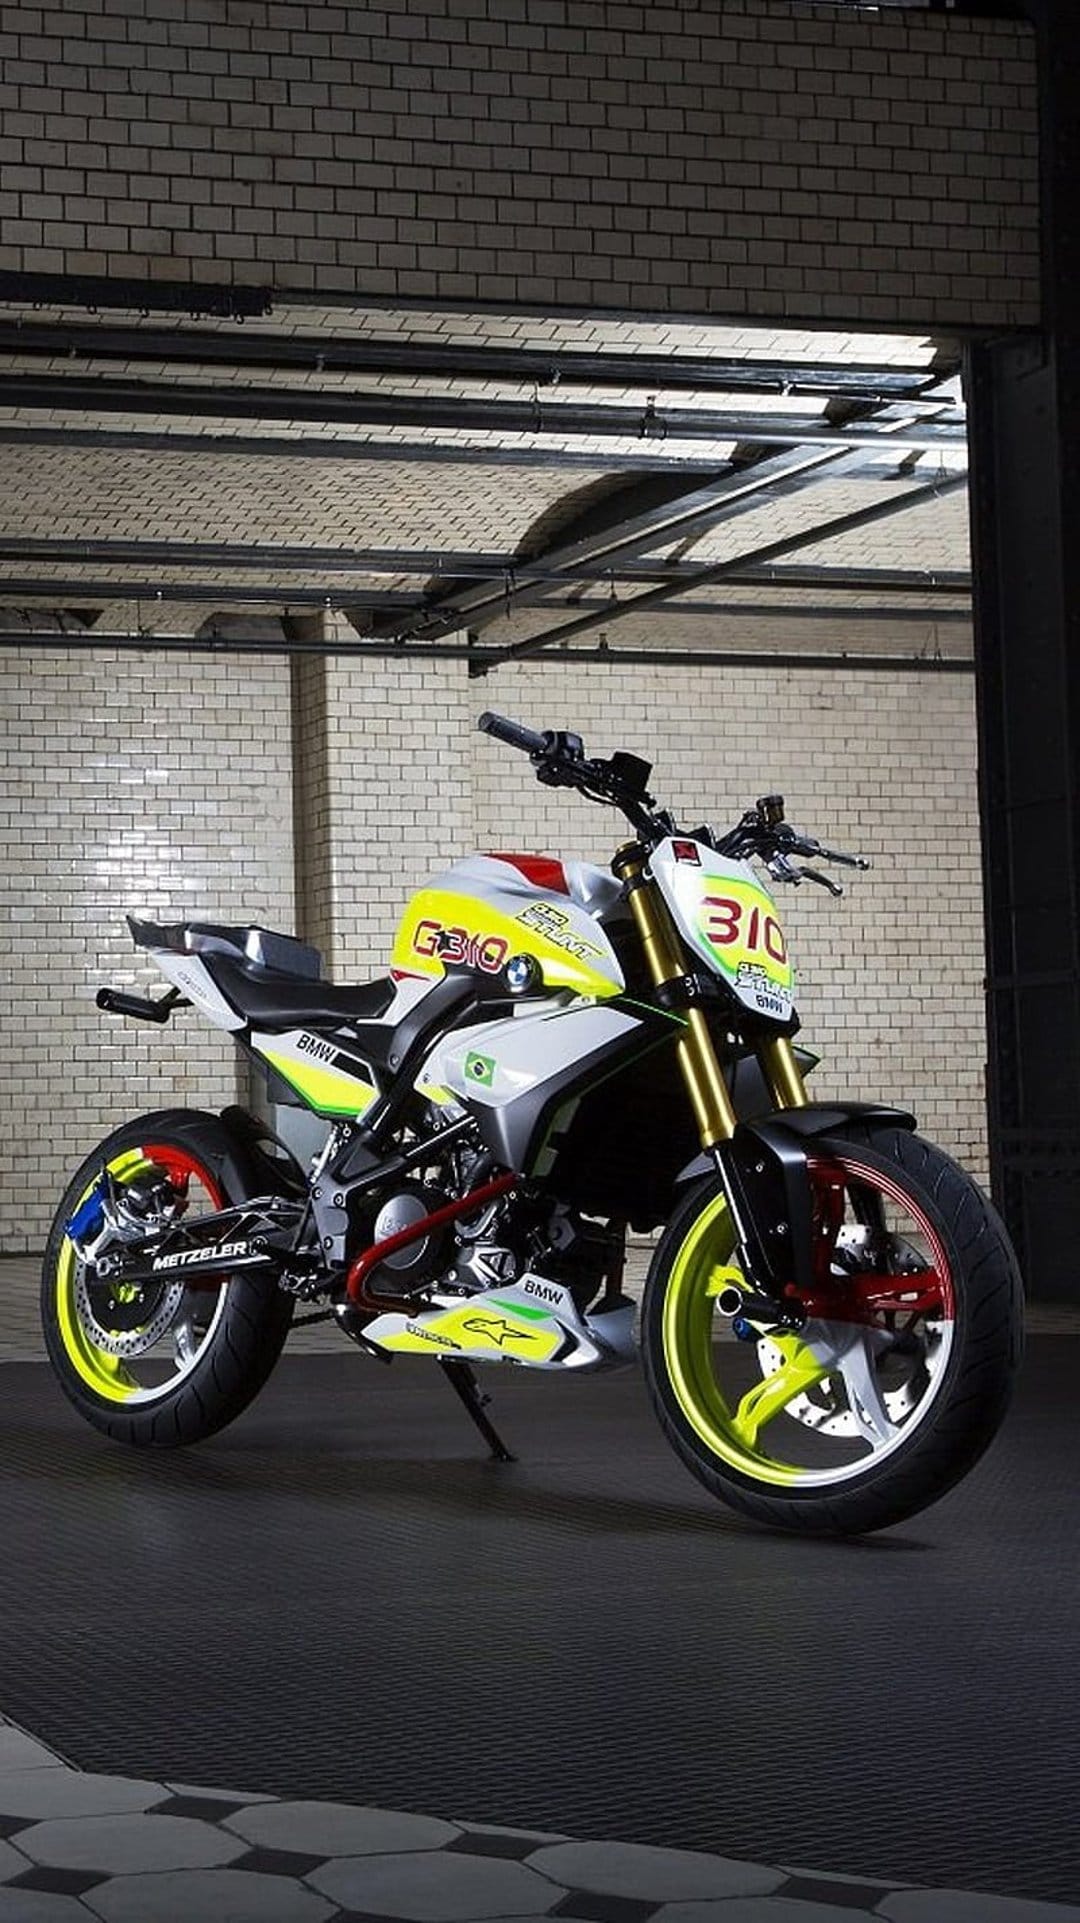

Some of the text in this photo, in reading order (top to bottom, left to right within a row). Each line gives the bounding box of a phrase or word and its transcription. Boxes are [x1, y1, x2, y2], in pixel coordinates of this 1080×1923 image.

[701, 896, 787, 965] 310
[413, 919, 509, 974] G310
[296, 1033, 336, 1064] BMW
[152, 1240, 247, 1271] METZELER
[523, 1279, 564, 1305] BMW
